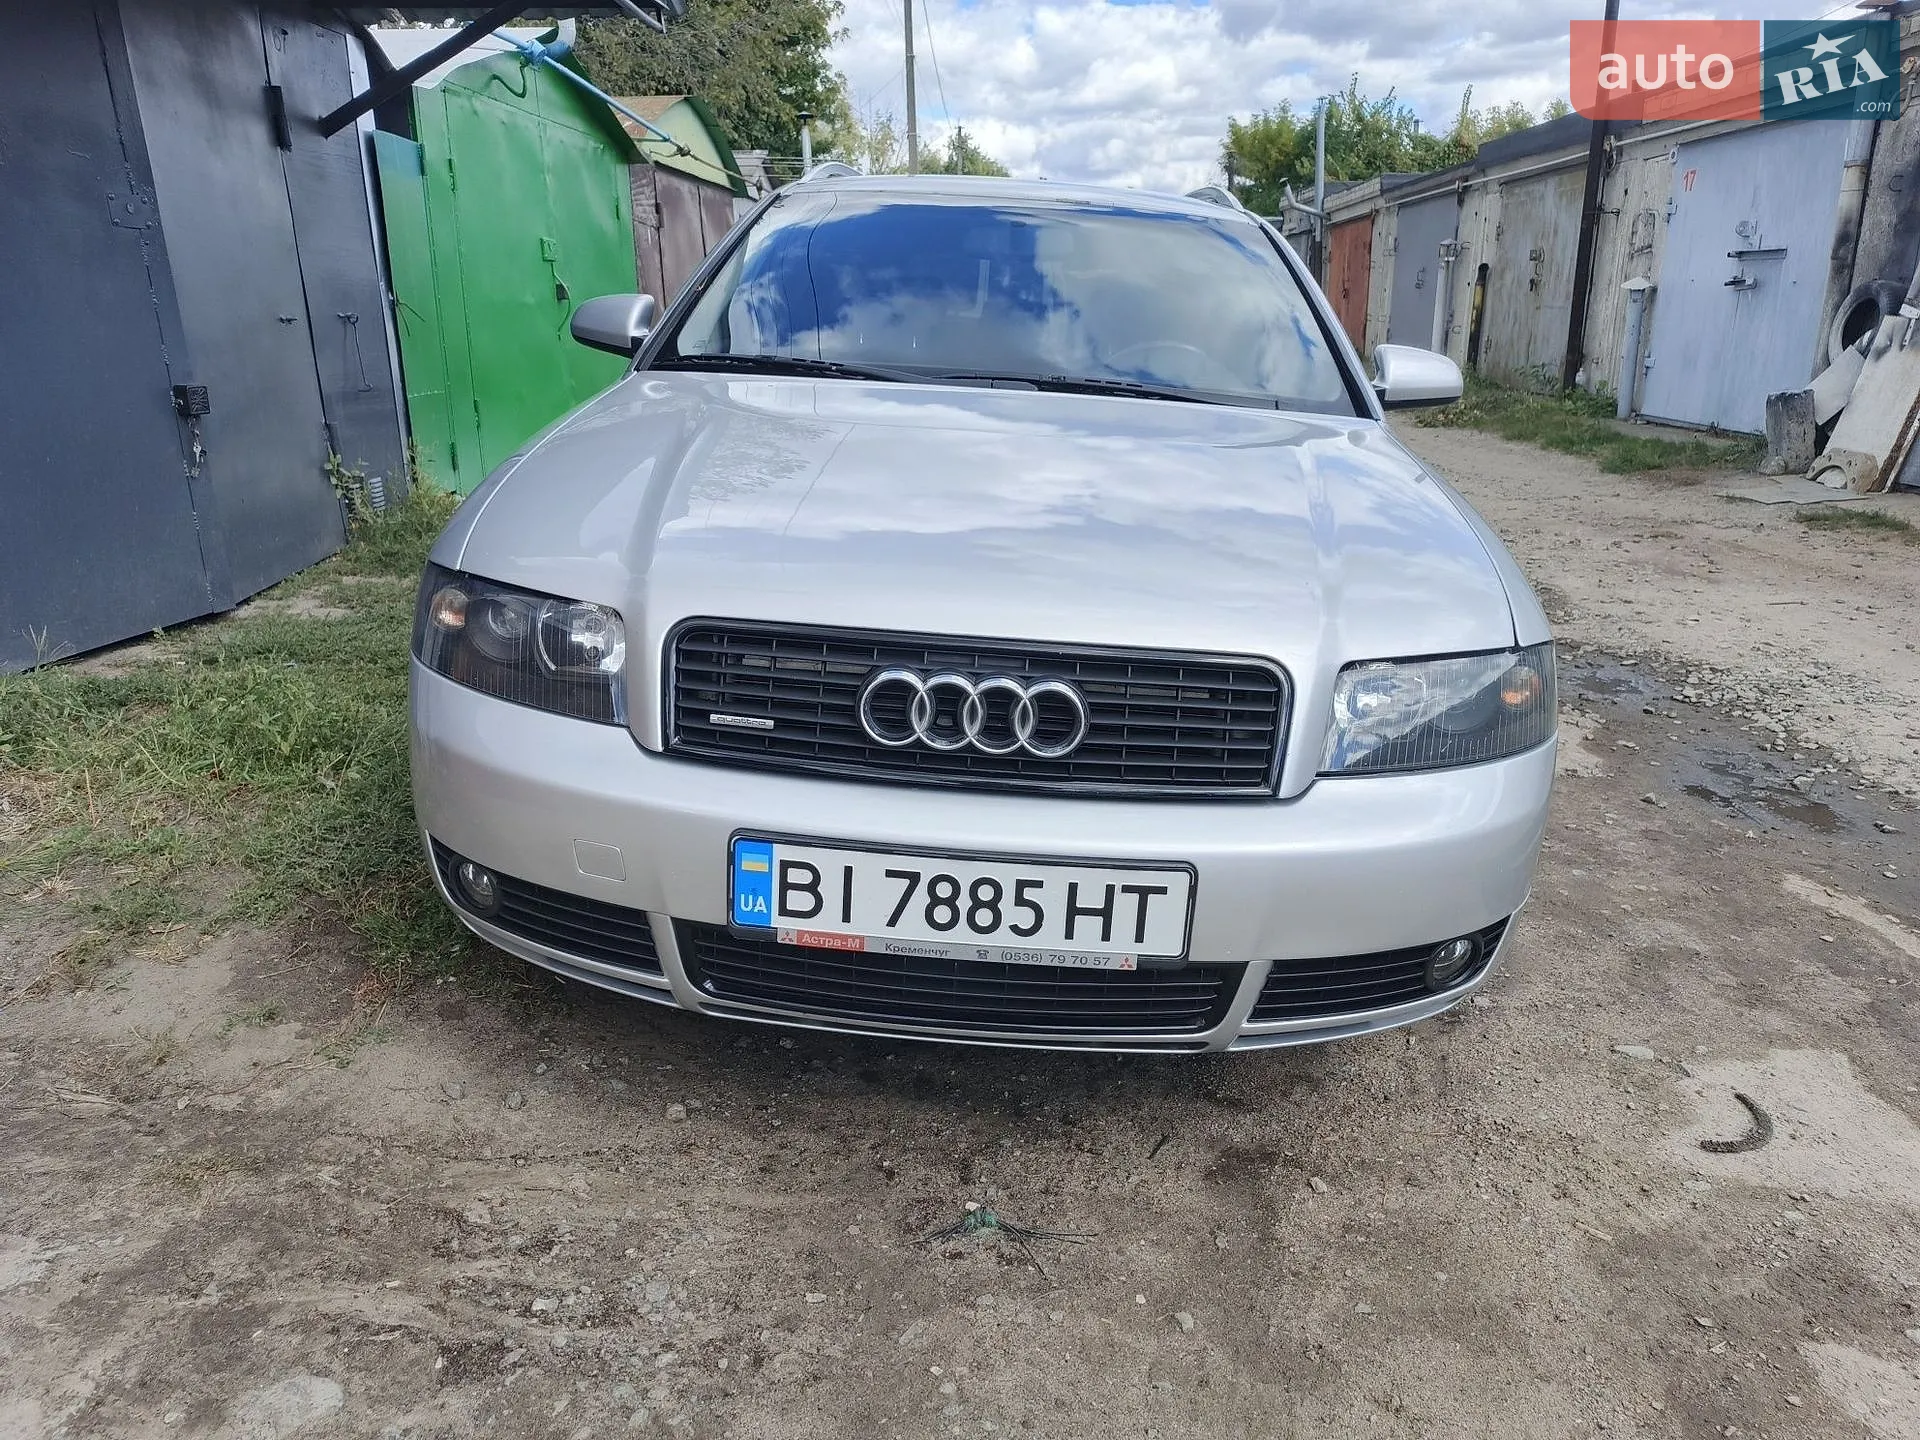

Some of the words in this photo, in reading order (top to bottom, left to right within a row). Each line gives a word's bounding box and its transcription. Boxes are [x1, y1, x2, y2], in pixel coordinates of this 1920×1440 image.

[1683, 169, 1697, 192] 17
[717, 716, 766, 727] quattro
[740, 894, 768, 914] UA
[778, 859, 853, 924] BI
[885, 869, 1044, 938] 7885
[1064, 882, 1168, 944] HT
[802, 933, 861, 950] Астра-М
[884, 942, 951, 958] Кременчуг
[1001, 951, 1043, 964] (0536)
[1049, 953, 1066, 964] 79
[1070, 955, 1087, 965] 70
[1093, 956, 1111, 967] 57
